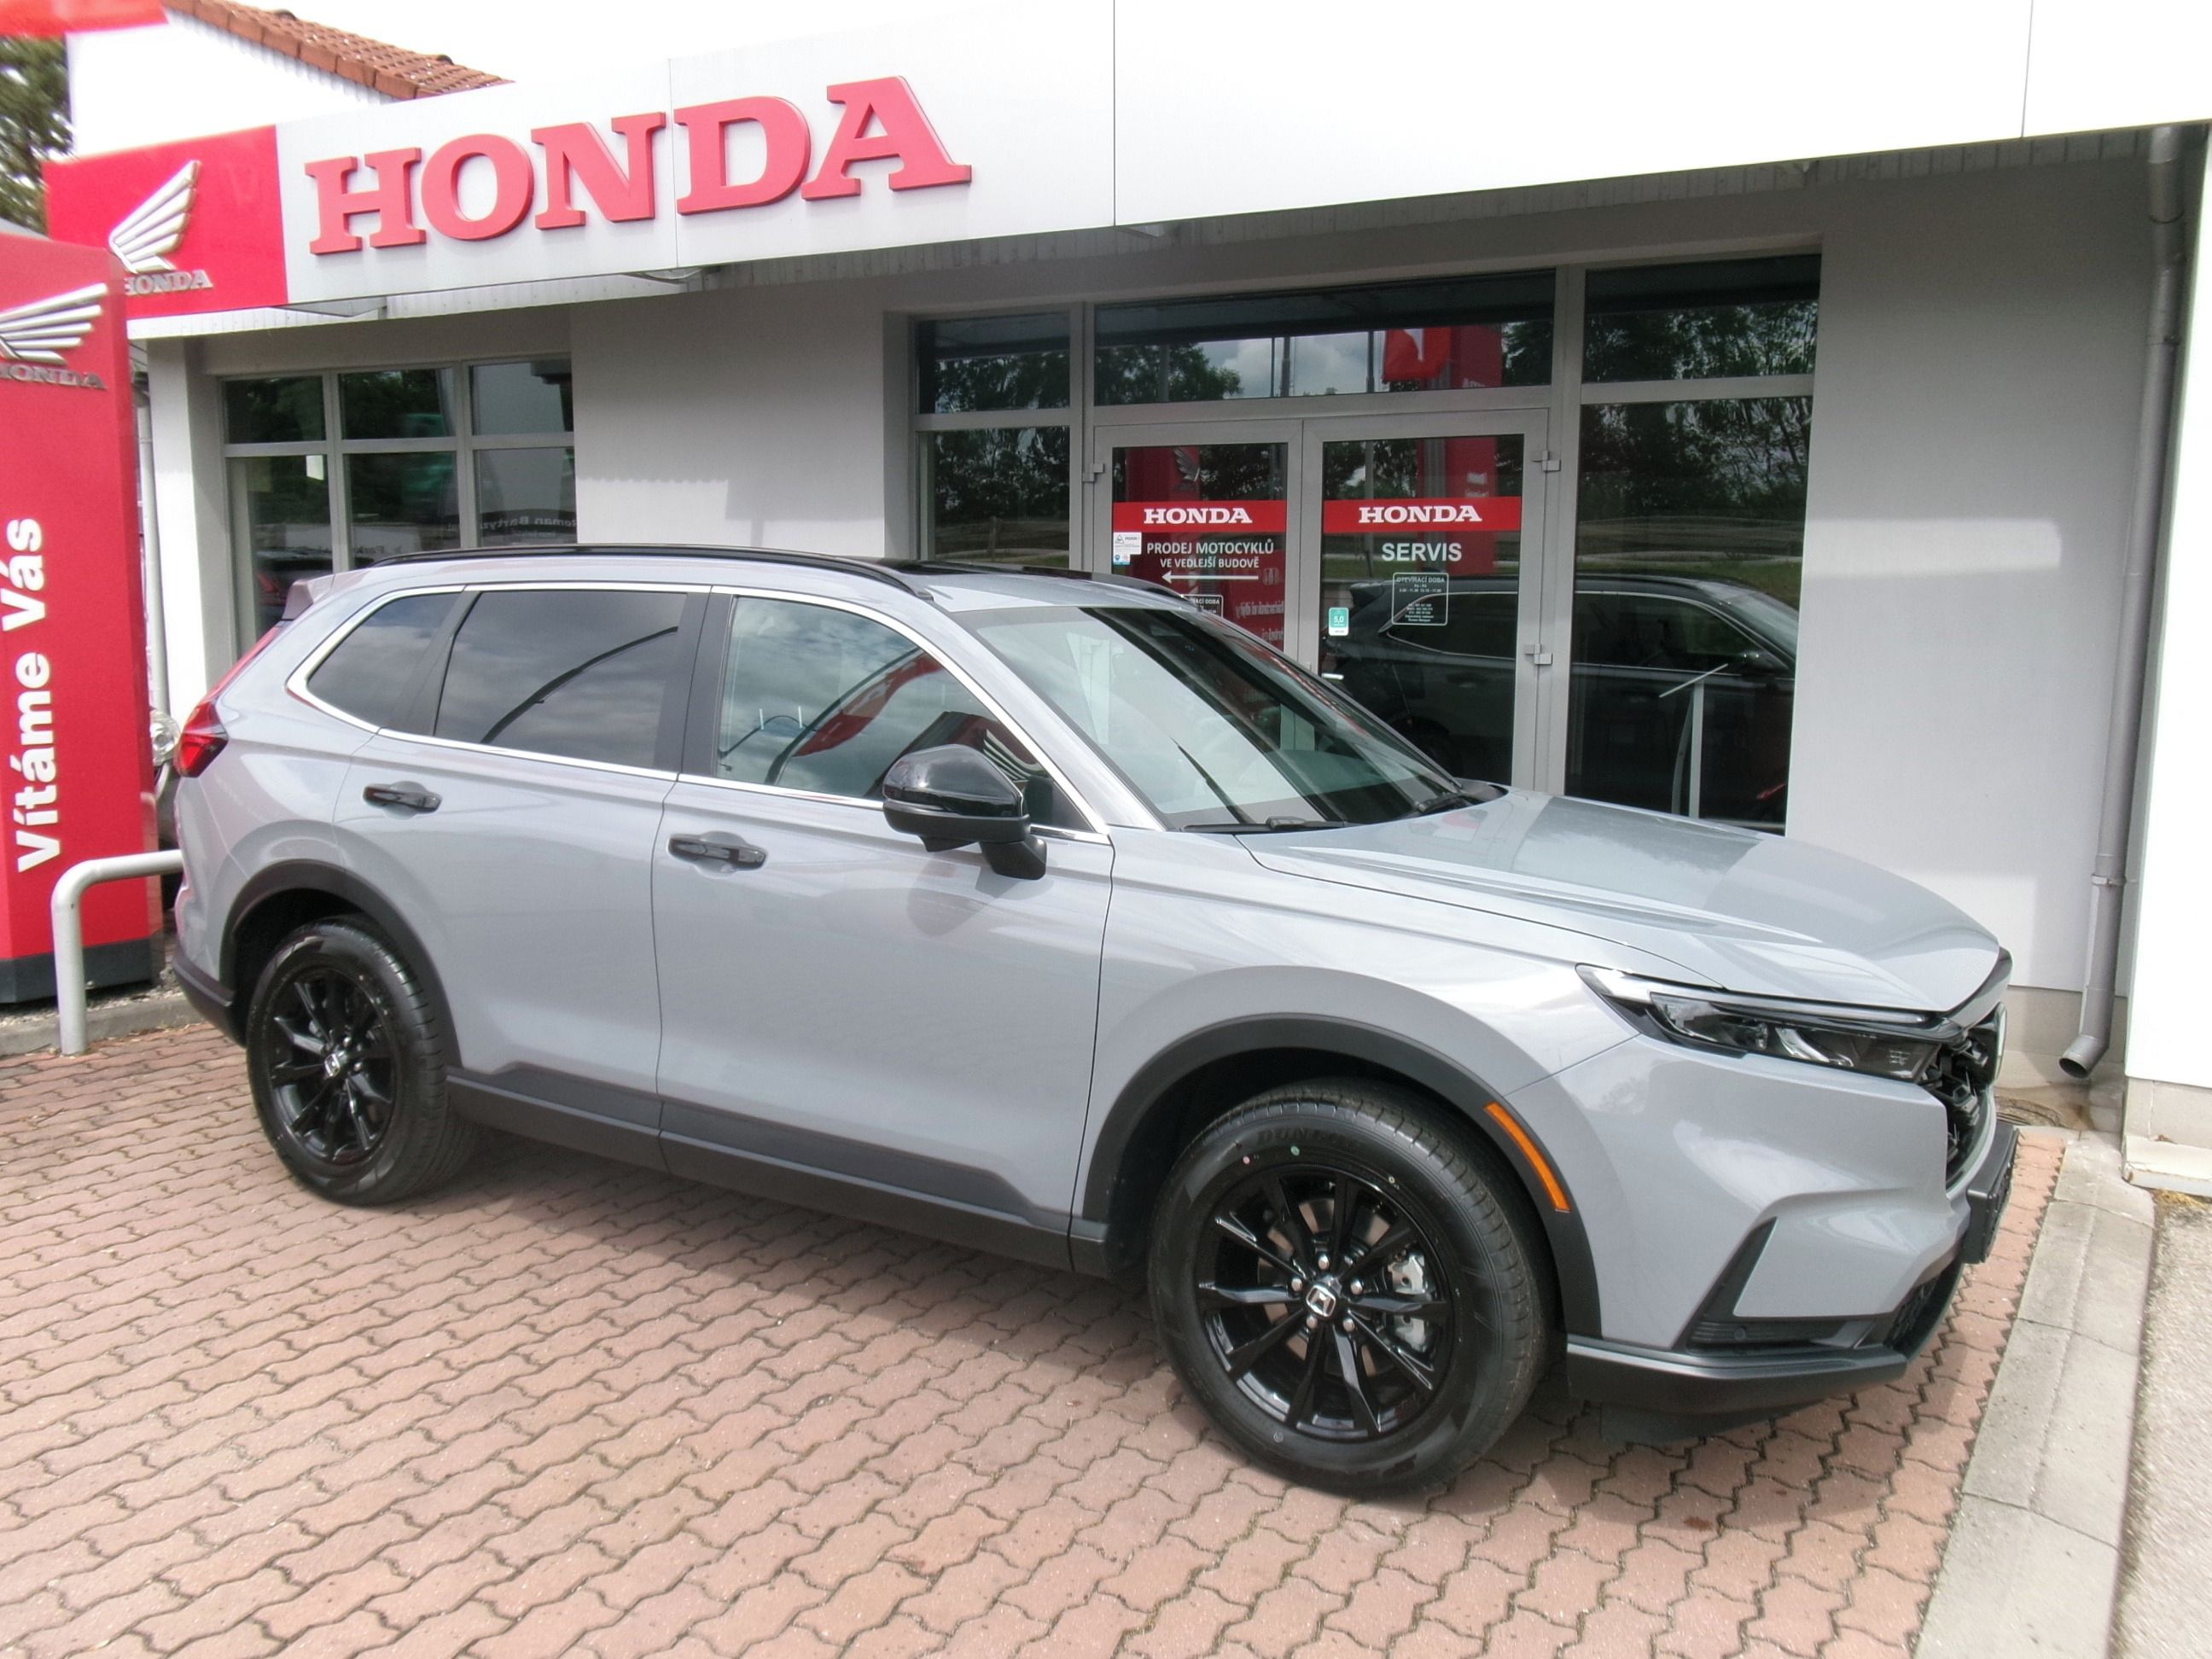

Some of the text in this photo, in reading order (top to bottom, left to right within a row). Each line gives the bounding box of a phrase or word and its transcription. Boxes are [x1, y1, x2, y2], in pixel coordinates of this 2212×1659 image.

[304, 75, 973, 256] HONDA
[1144, 507, 1253, 524] HONDA
[1359, 505, 1482, 524] HONDA
[1147, 538, 1274, 555] PRODEJ MOTOCYKLŮ
[1382, 543, 1462, 562] SERVIS
[1160, 556, 1259, 568] VE VEDLEJŠÍ BUDOVĚ
[0, 518, 61, 873] Vítáme Vás
